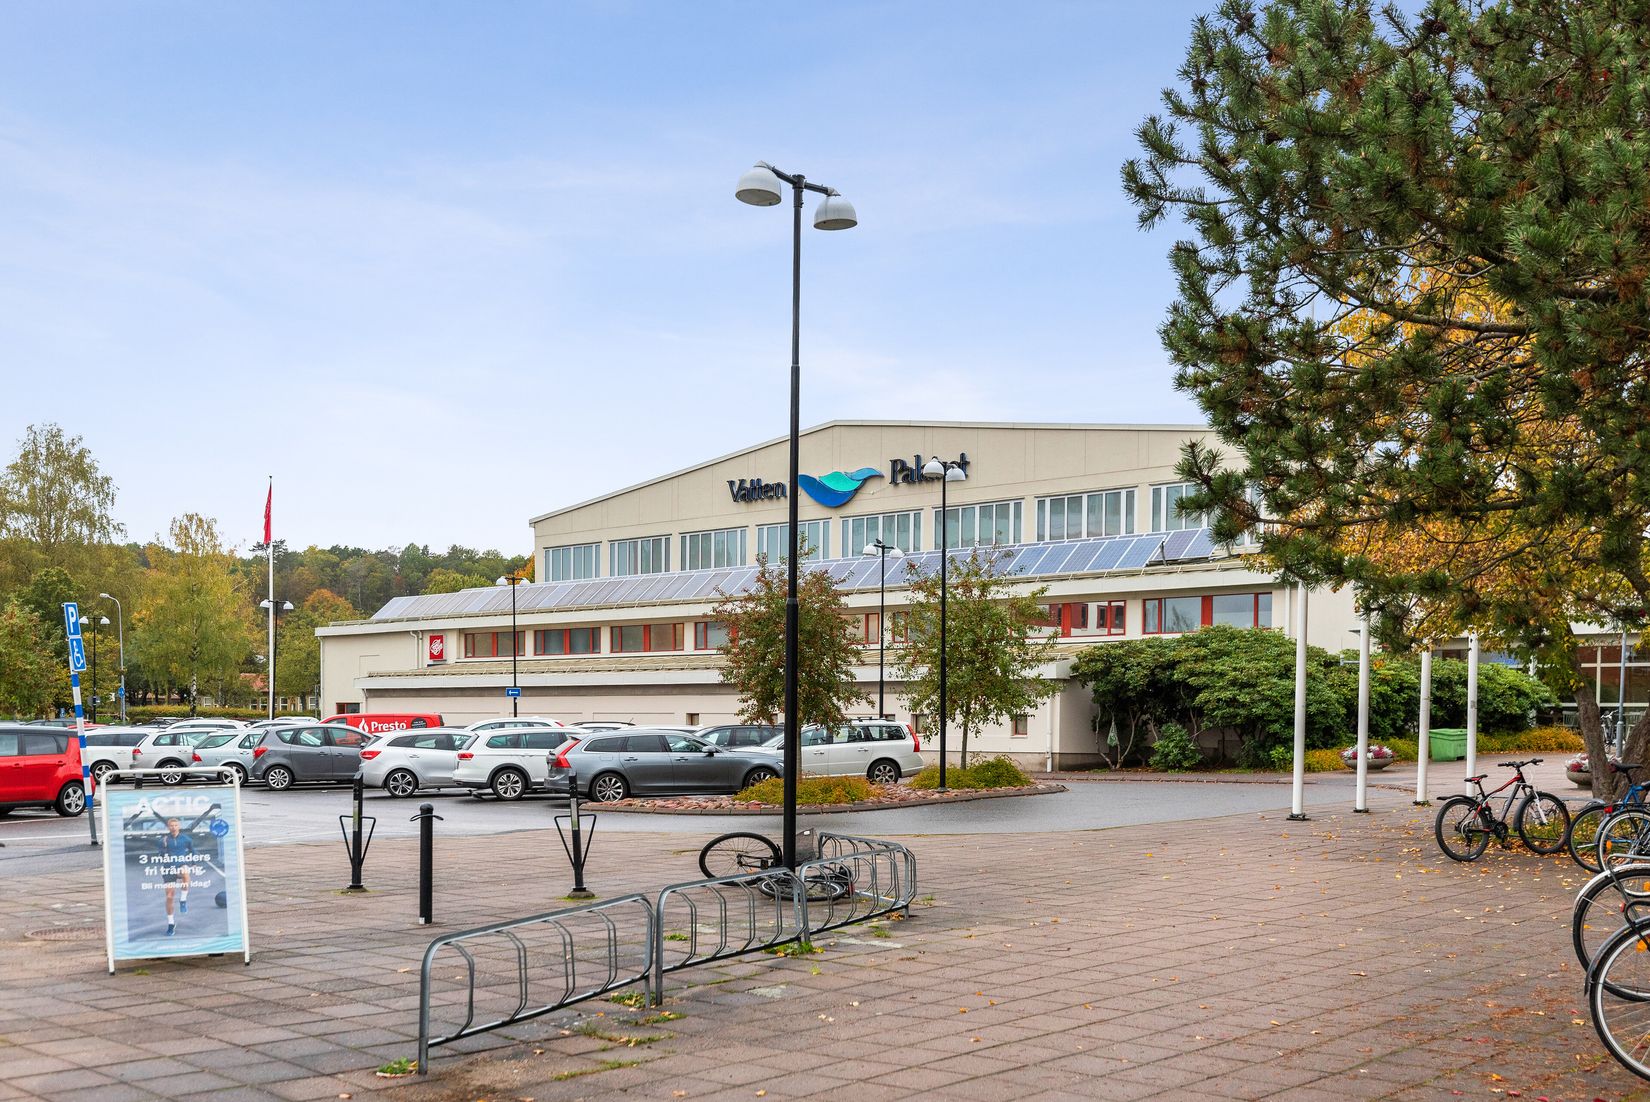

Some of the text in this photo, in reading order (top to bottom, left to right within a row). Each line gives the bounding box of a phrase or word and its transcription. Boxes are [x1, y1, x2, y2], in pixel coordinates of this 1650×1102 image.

[727, 453, 970, 502] Vatten Palt
[68, 607, 76, 633] P
[371, 721, 407, 732] Presto
[139, 853, 211, 864] 3 månaders
[144, 866, 158, 876] fri
